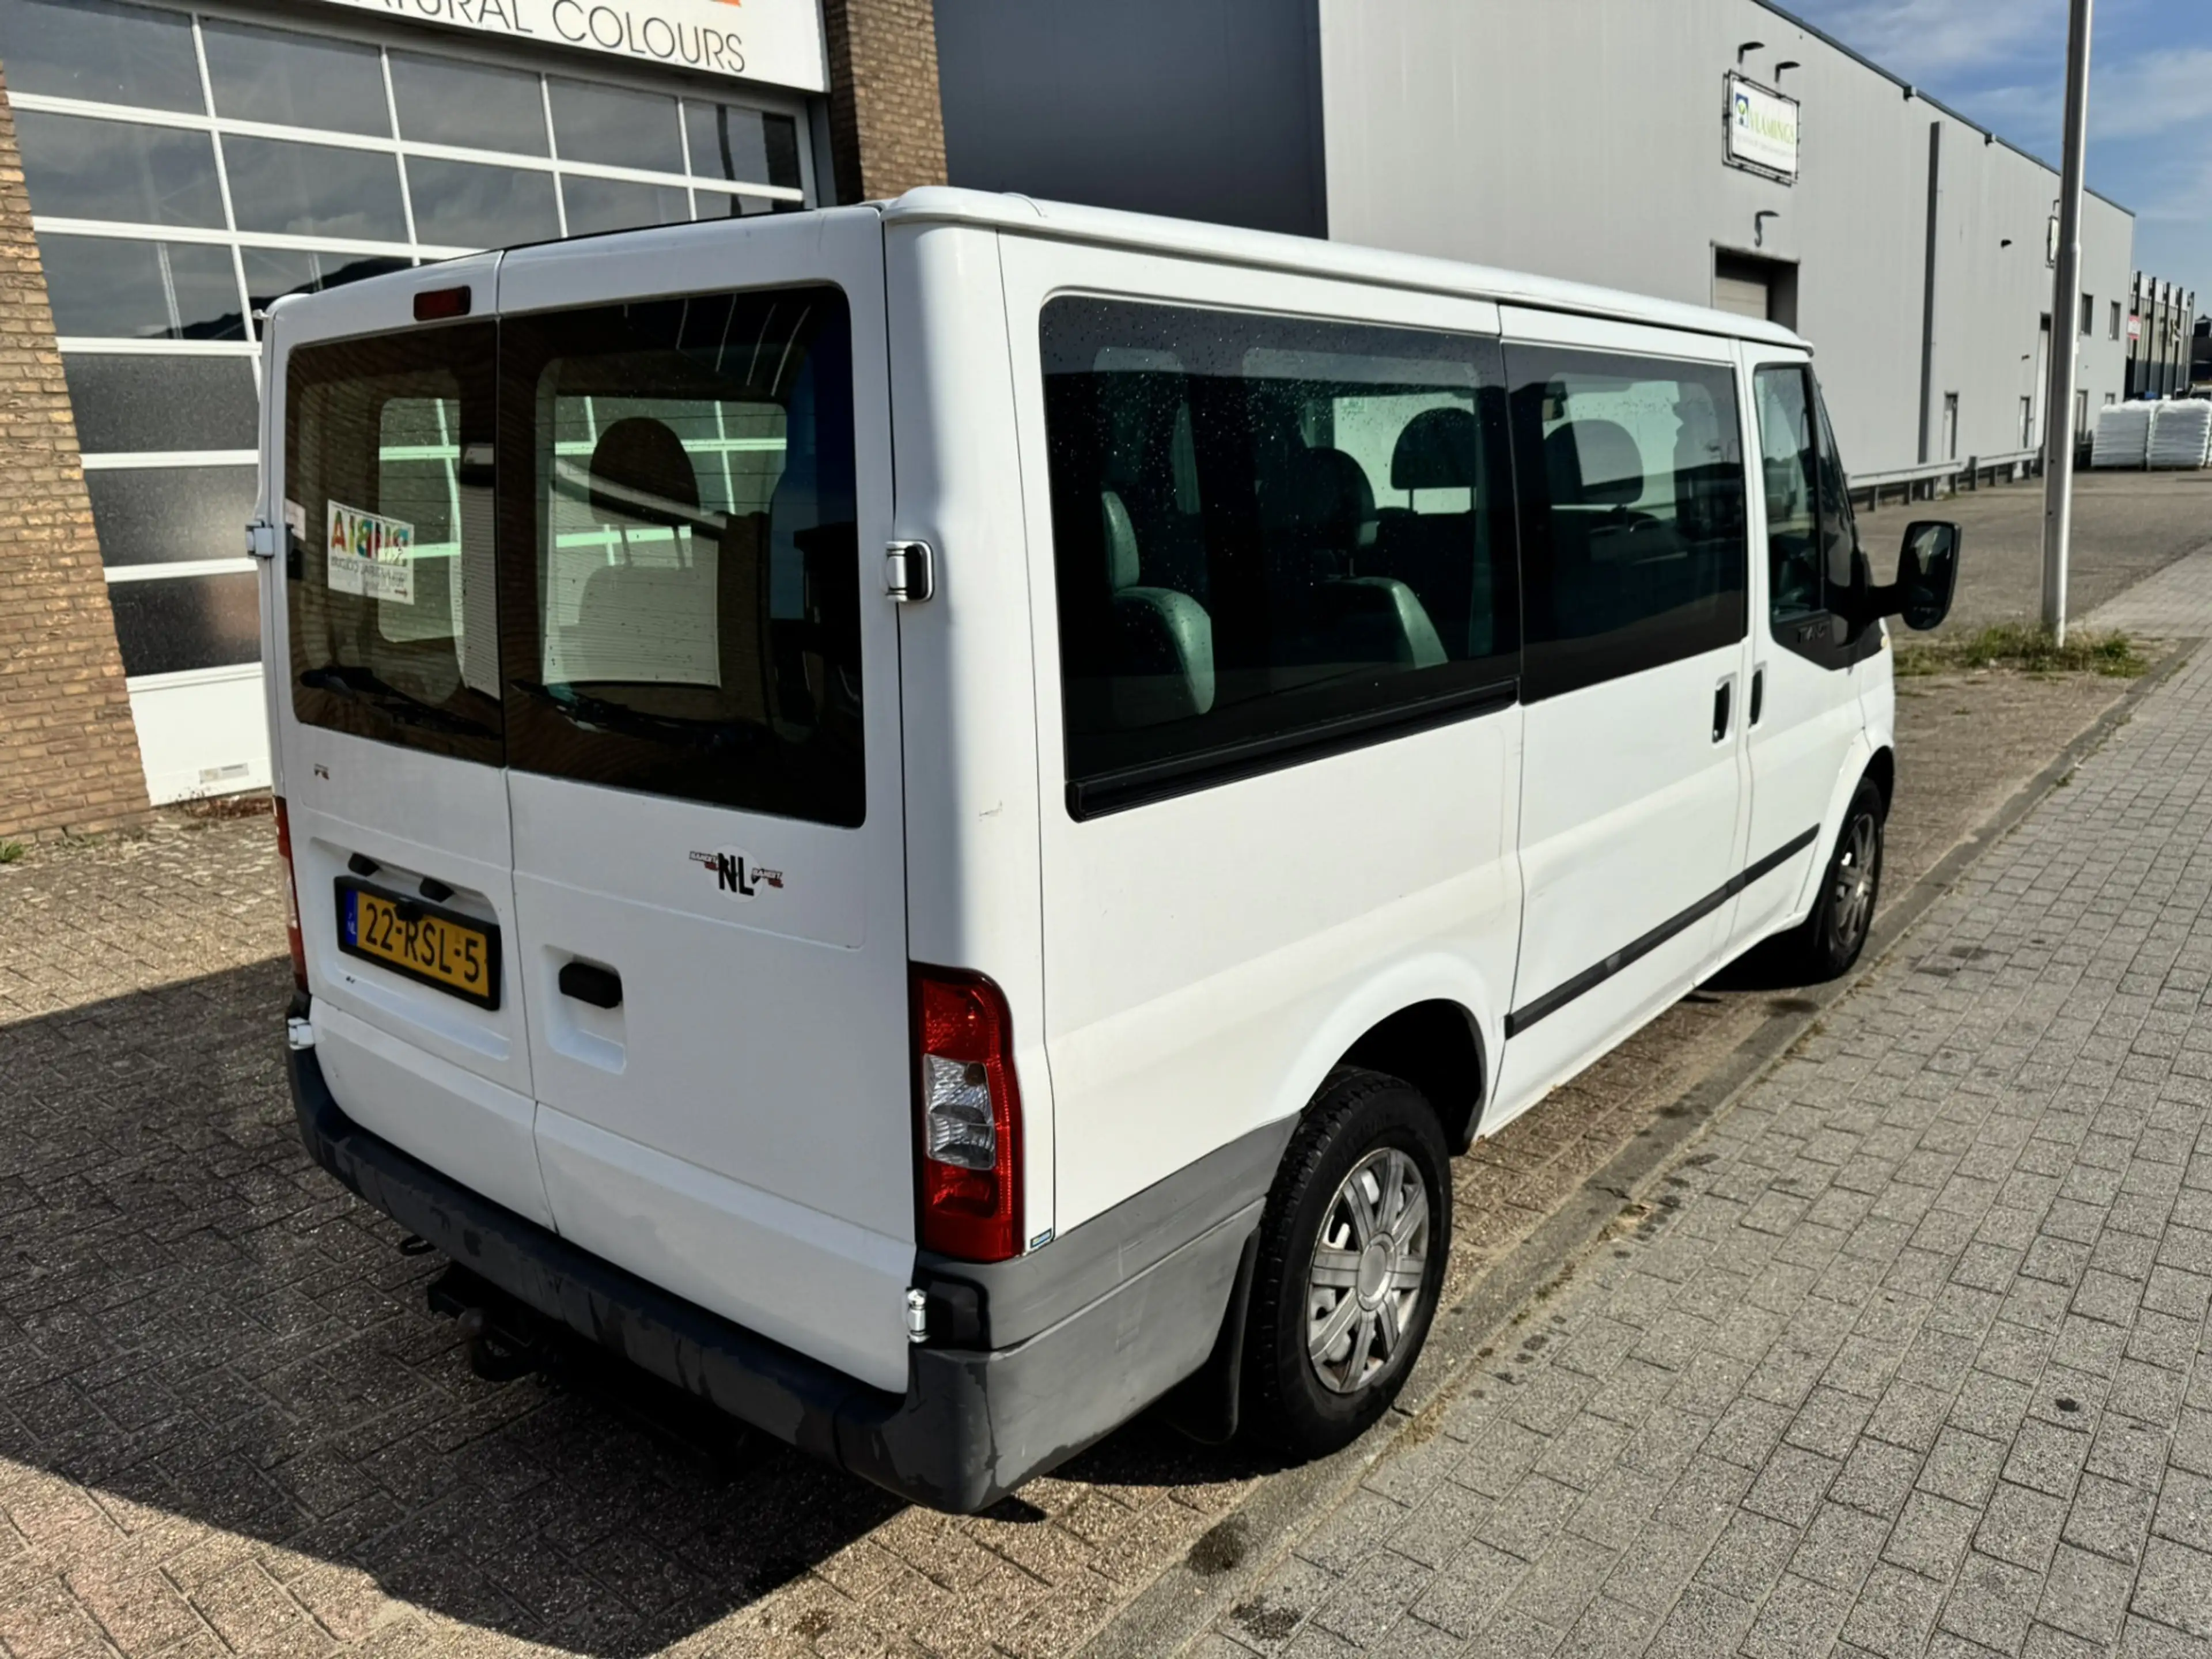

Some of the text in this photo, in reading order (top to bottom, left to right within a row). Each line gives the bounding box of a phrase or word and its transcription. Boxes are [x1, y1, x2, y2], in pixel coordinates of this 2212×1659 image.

[552, 0, 745, 72] COLOURS
[718, 853, 755, 896] NL
[365, 902, 479, 983] 22-RSL-5
